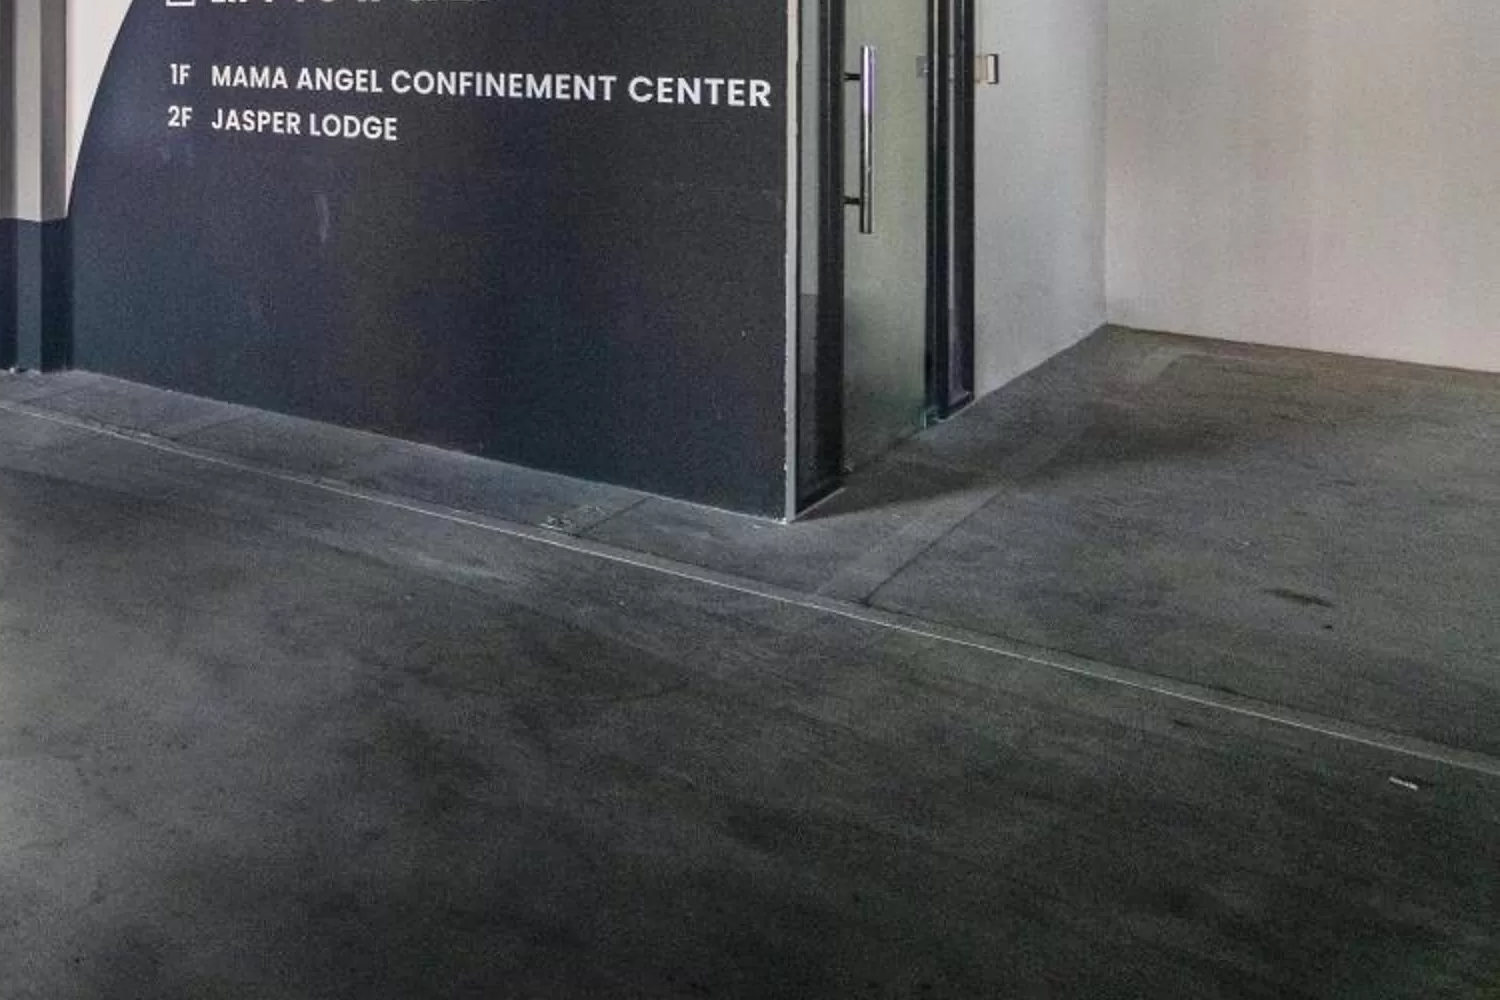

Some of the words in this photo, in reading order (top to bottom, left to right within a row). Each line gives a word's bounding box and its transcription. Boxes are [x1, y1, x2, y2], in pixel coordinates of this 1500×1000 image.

[169, 63, 191, 86] 1F
[211, 64, 289, 89] MAMA
[296, 67, 383, 93] ANGEL
[390, 69, 618, 101] CONFINEMENT
[627, 75, 771, 108] CENTER
[167, 104, 193, 128] 2F
[211, 107, 301, 135] JASPER
[309, 112, 398, 141] LODGE
